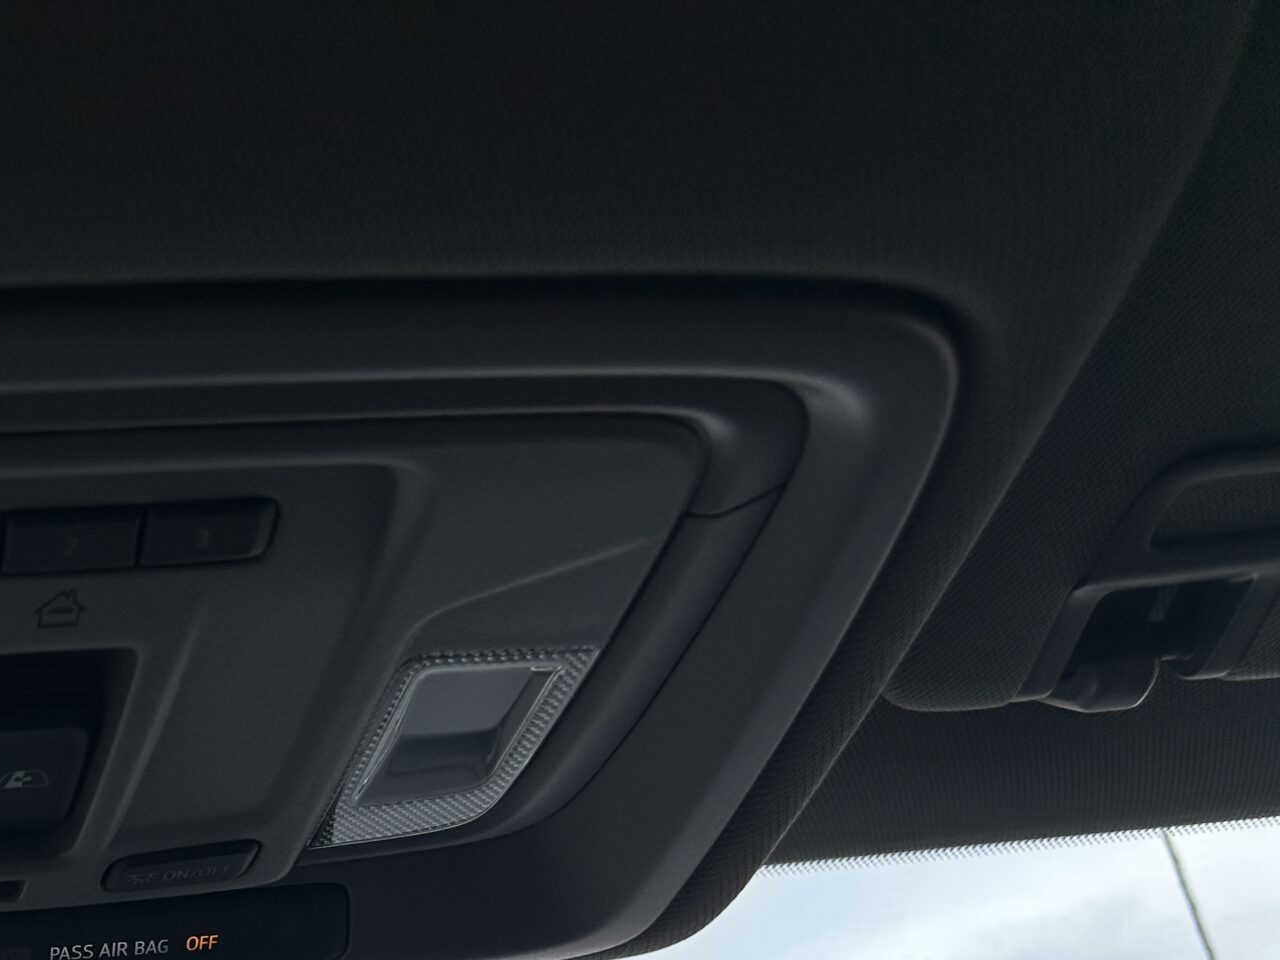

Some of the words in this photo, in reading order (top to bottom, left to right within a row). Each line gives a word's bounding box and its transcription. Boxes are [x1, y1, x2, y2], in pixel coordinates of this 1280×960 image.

[64, 539, 78, 557] 2
[195, 529, 209, 547] 3
[99, 941, 128, 958] AIR
[134, 939, 168, 955] BAG
[186, 935, 218, 951] OFF
